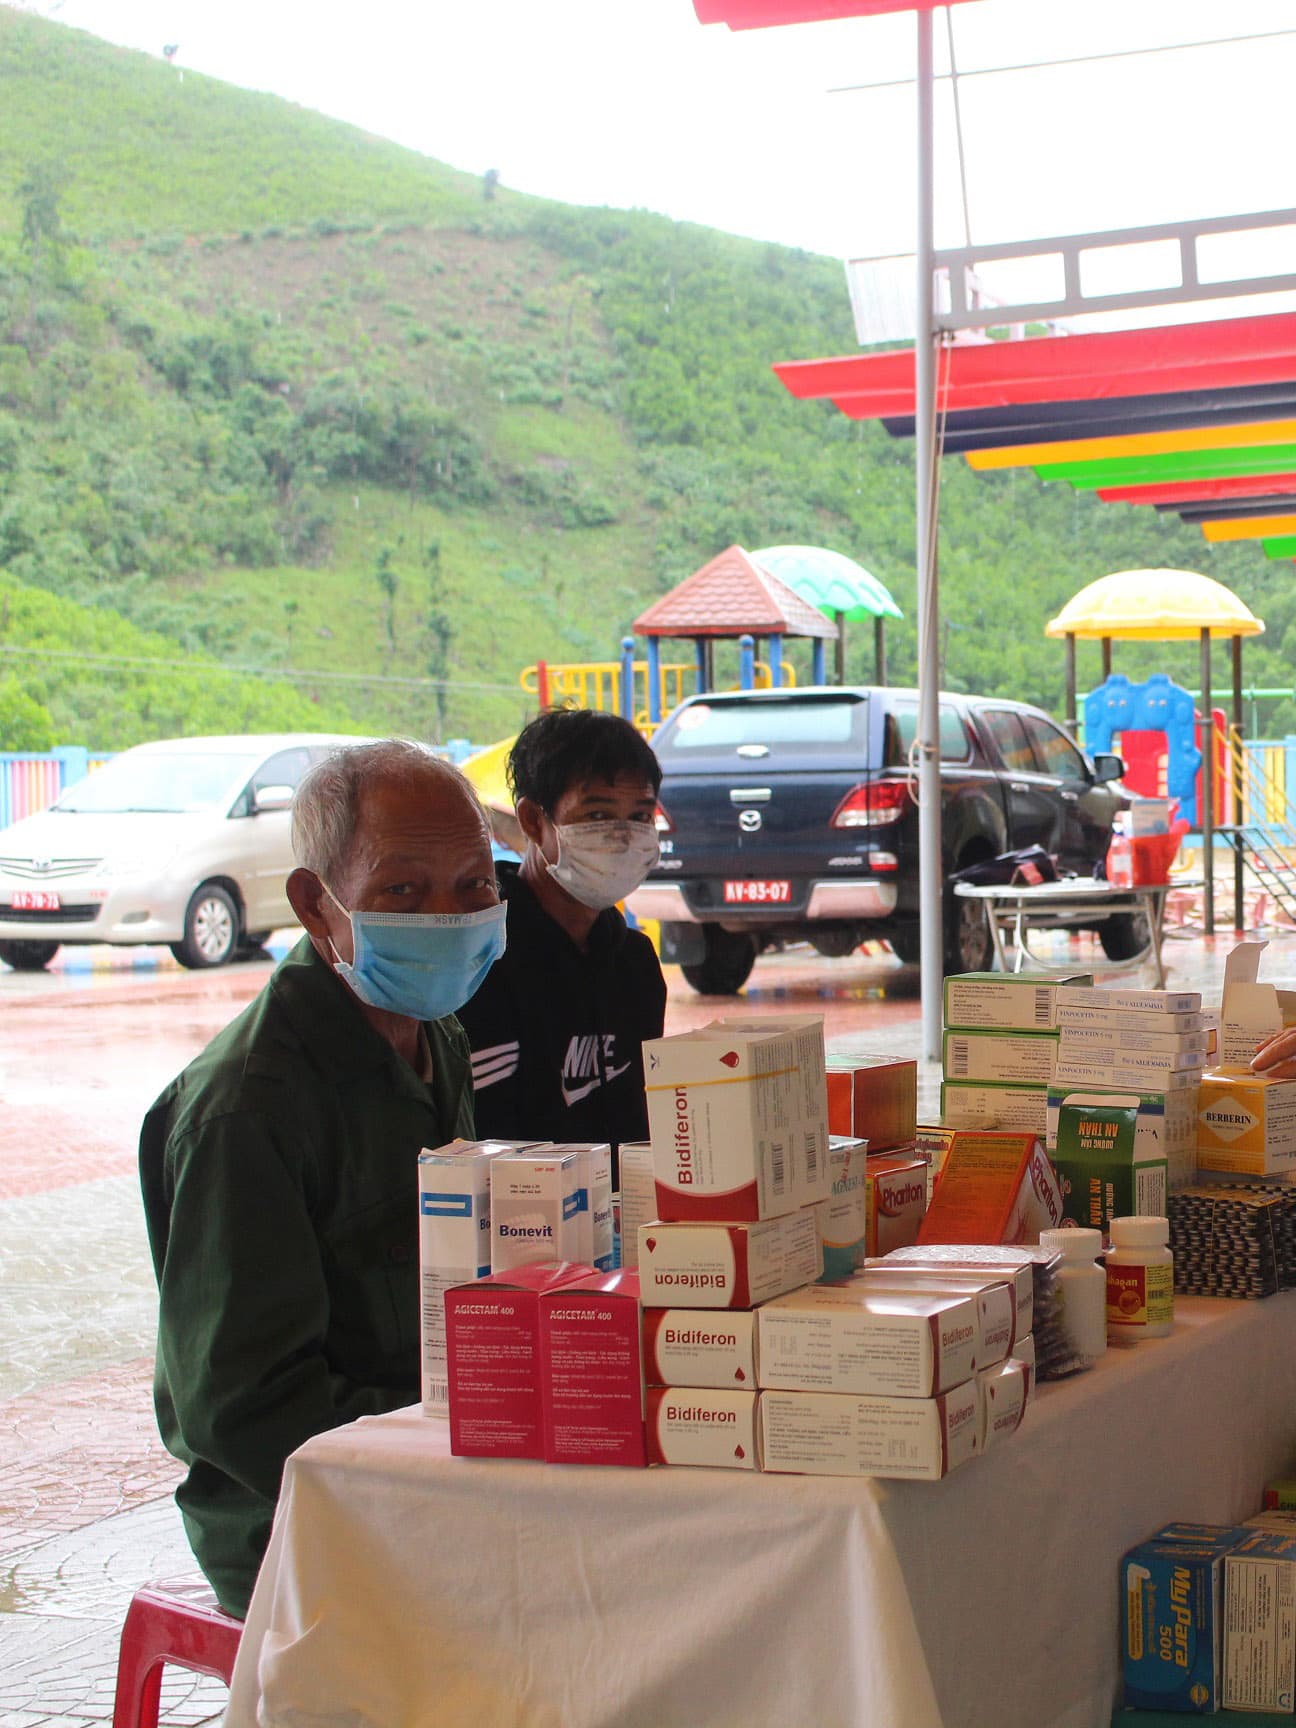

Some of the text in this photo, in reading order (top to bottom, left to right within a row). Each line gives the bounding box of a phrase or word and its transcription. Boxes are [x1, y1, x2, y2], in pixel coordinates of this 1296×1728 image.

[1206, 1112, 1252, 1124] BERBERIN
[675, 1086, 692, 1184] Bidiferon
[1105, 1123, 1119, 1137] AN
[500, 1225, 552, 1237] Bonevit
[655, 1274, 726, 1288] Bidiferon
[500, 1307, 514, 1315] 400
[597, 1312, 612, 1320] 400
[665, 1330, 737, 1345] Bidiferon
[666, 1407, 737, 1423] Bidiferon
[1159, 1624, 1173, 1662] 500
